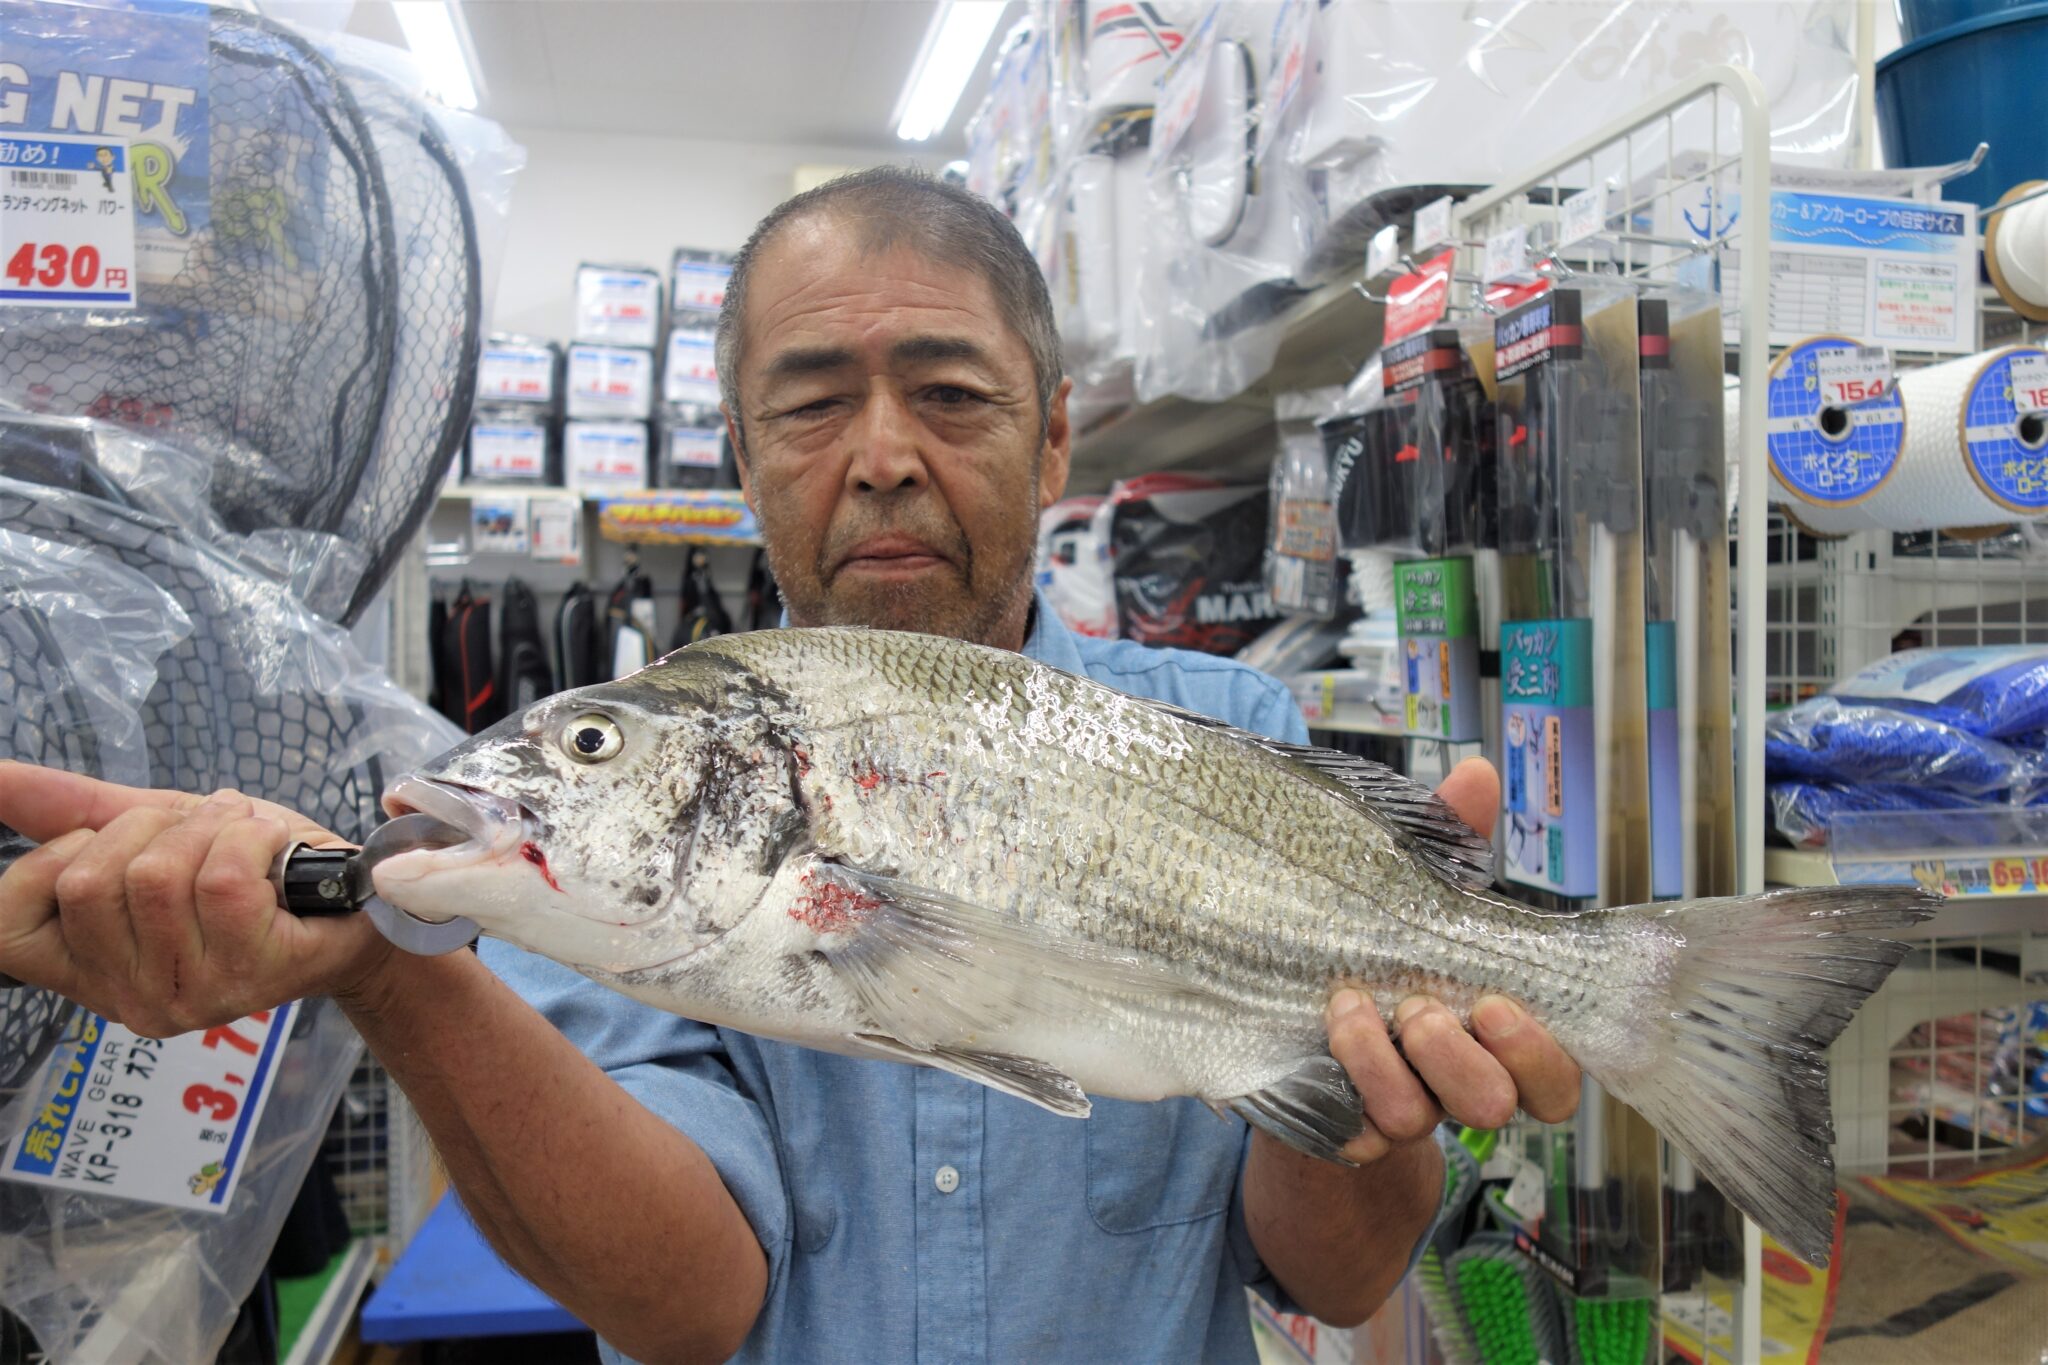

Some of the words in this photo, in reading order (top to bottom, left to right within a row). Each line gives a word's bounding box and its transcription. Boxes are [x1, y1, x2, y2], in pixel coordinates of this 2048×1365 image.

[50, 70, 198, 140] NET
[58, 1119, 96, 1180] WAVE
[88, 1040, 124, 1102] GEAR
